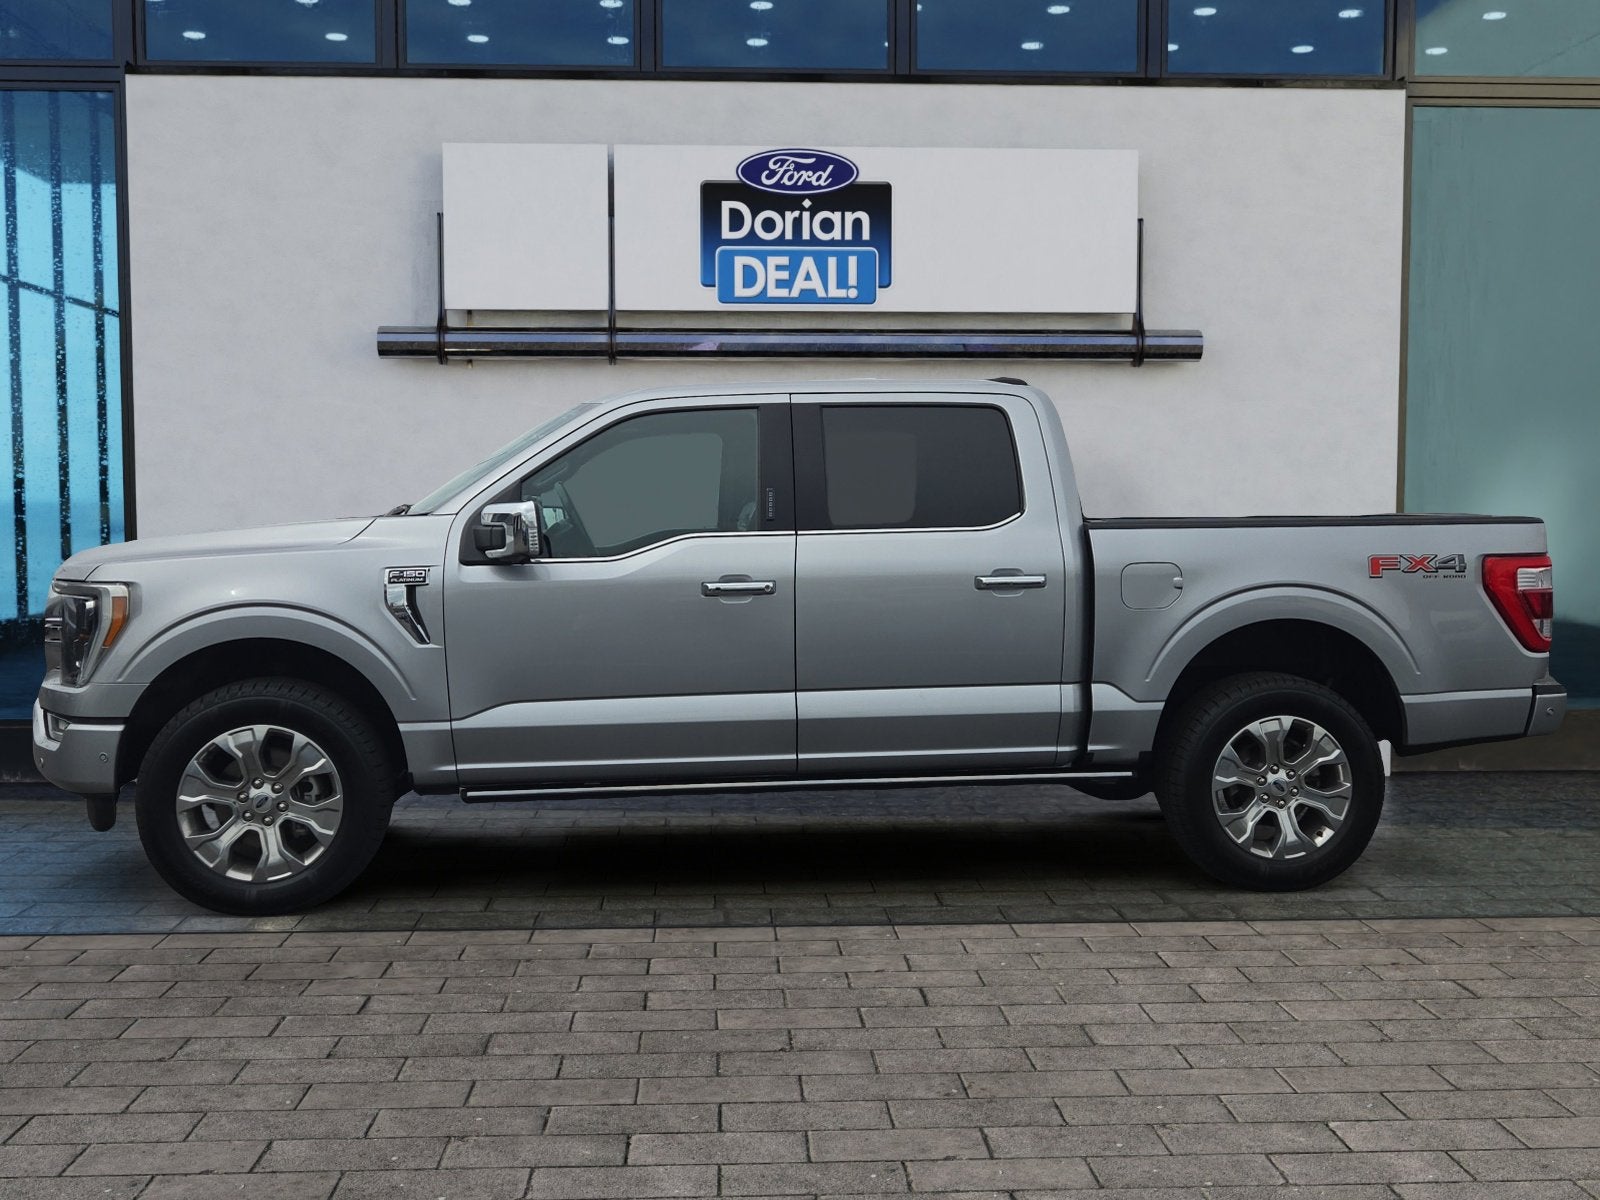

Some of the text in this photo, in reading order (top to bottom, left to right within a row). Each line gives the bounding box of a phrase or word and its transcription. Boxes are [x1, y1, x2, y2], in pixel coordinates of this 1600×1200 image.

[761, 155, 835, 186] Ford
[720, 198, 871, 240] Dorian
[734, 255, 859, 299] DEAL!
[389, 570, 426, 578] F-150
[1368, 553, 1467, 578] FX4
